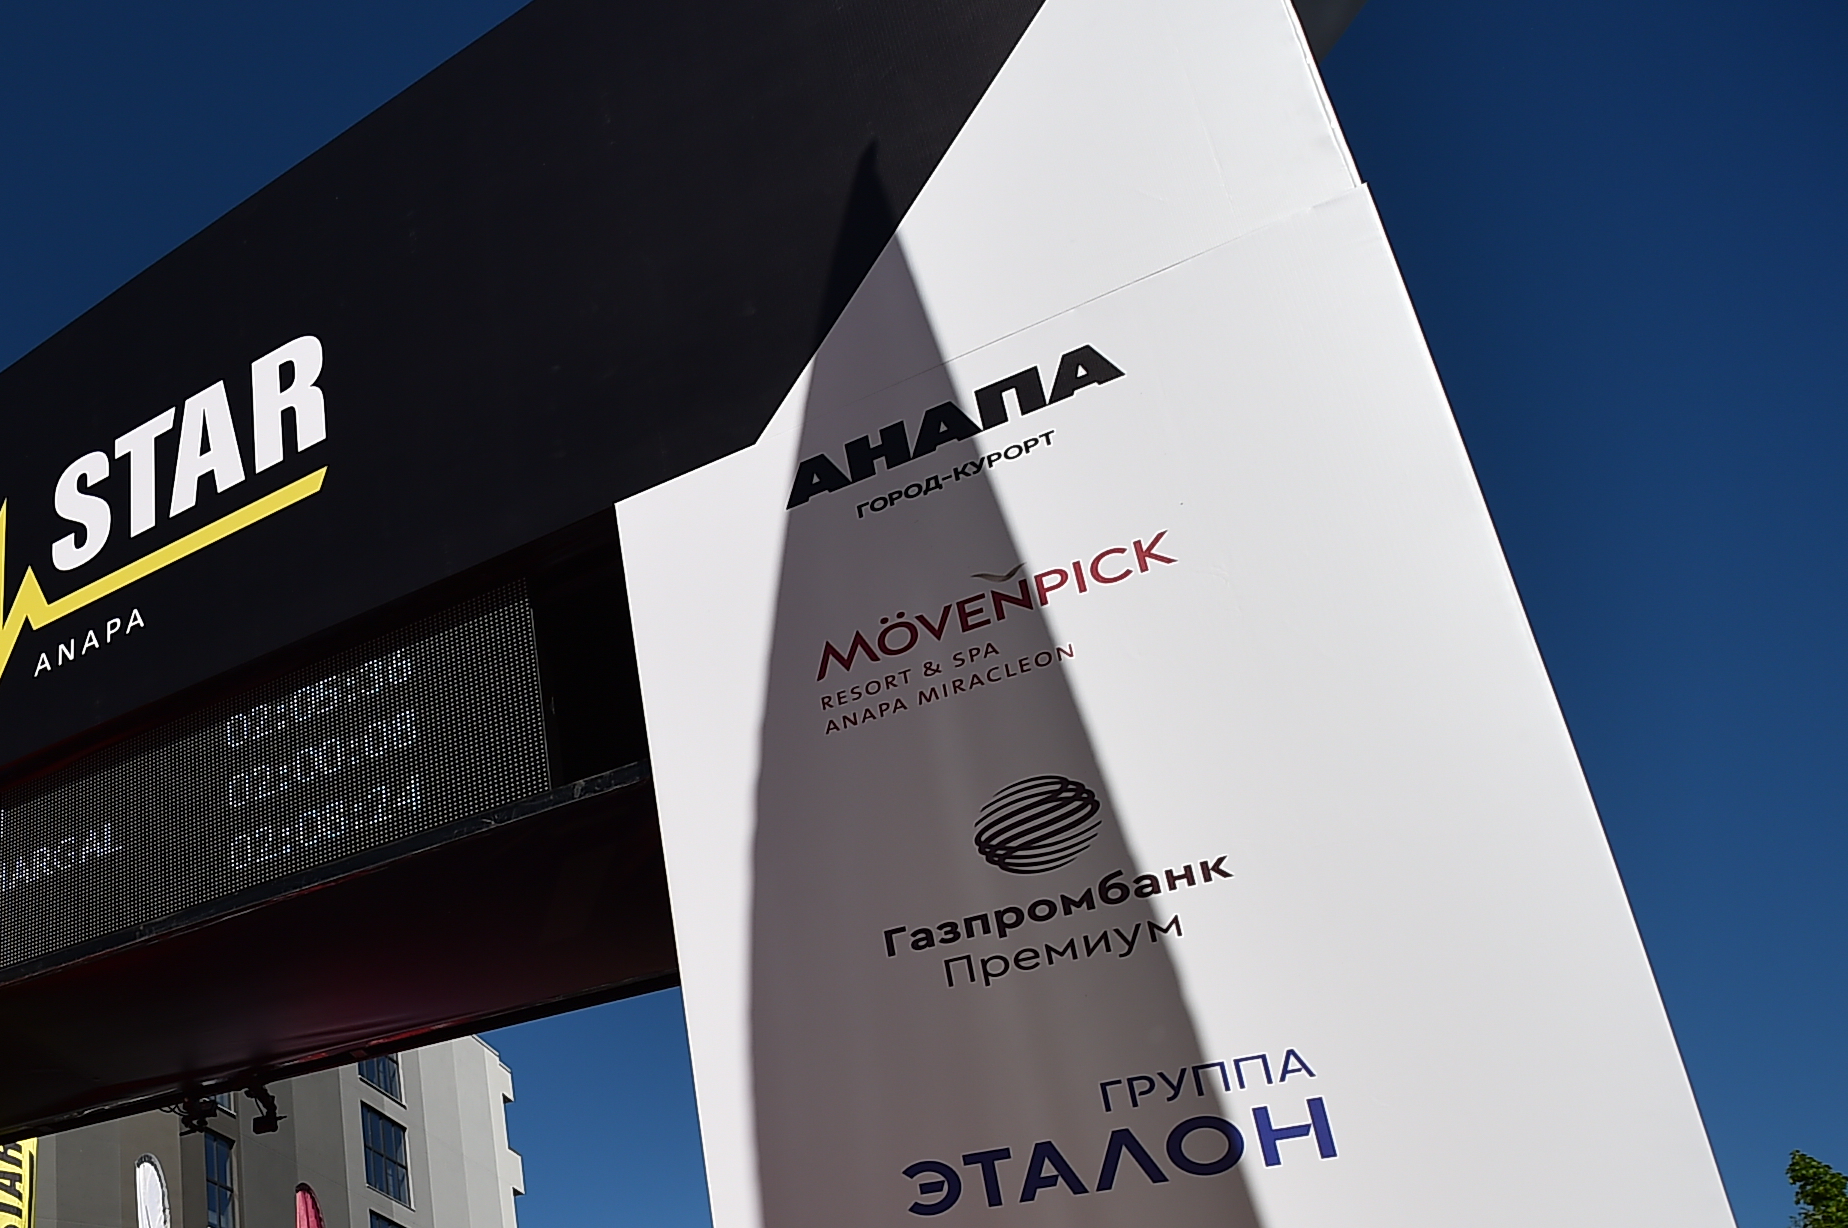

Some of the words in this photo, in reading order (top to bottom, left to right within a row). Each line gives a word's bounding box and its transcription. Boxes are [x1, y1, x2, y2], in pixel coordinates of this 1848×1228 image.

[53, 336, 326, 571] STAR
[786, 344, 1125, 511] АНАПА
[855, 430, 1056, 518] ГОРОД-КУРОРТ
[34, 608, 145, 678] ANAPA
[816, 529, 1178, 682] MÖVENPICK
[226, 649, 412, 748] 02:05:36
[820, 668, 912, 711] RESORT
[922, 657, 943, 679] &
[951, 641, 1001, 669] SPA
[823, 696, 908, 735] ANAPA
[916, 642, 1075, 706] MIRACLEON
[883, 855, 1234, 957] Газпромбанк
[942, 913, 1183, 988] Премиум
[1099, 1047, 1316, 1112] ГРУППА
[901, 1096, 1338, 1216] ЭТАЛОН
